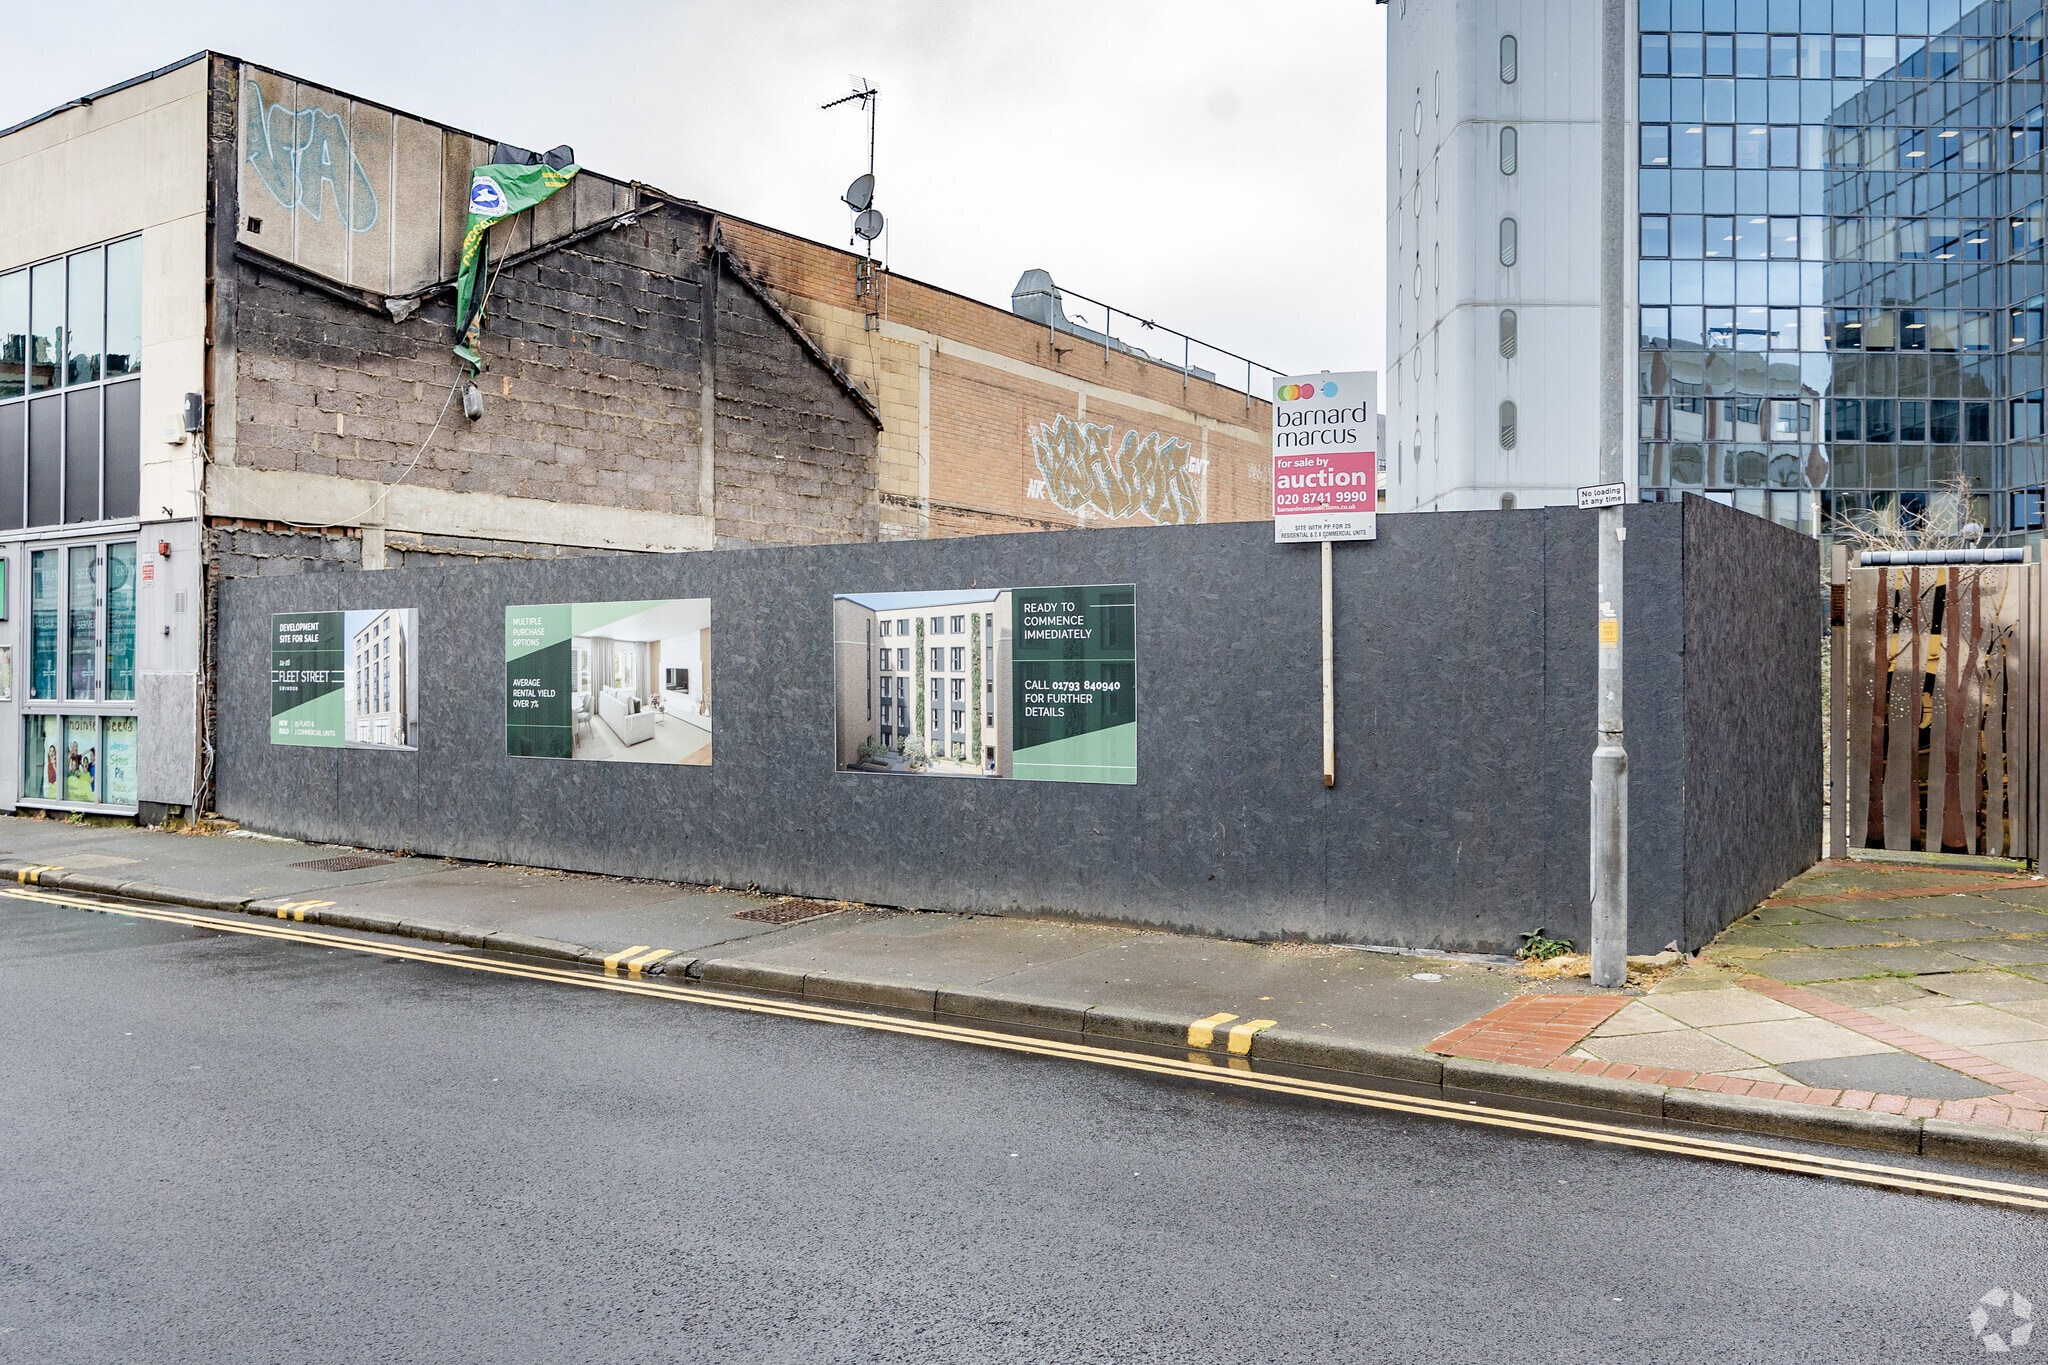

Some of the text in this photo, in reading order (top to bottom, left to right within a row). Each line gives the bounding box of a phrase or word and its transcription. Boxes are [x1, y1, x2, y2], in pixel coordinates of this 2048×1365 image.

[1277, 401, 1366, 428] barnard
[1277, 428, 1357, 448] marcus
[1277, 457, 1329, 468] for sale by
[1277, 468, 1366, 489] auction
[1594, 486, 1620, 496] loading
[1277, 490, 1367, 505] 020 8741 9990
[1024, 602, 1075, 613] READY TO
[512, 617, 542, 626] MULTIPLE
[1024, 615, 1084, 626] COMMENCE
[279, 622, 320, 632] DEVELOPMENT
[512, 628, 545, 636] PURCHASE
[279, 634, 319, 643] SITE FOR SALE
[1024, 628, 1092, 640] IMMEDIATELY
[512, 638, 540, 647] OPTIONS
[279, 670, 330, 682] FLEET STREET
[512, 678, 540, 687] AVERAGE
[1024, 680, 1121, 692] CALL 01793 840940
[513, 689, 556, 698] RENTAL YIELD
[1025, 694, 1093, 704] FOR FURTHER
[513, 700, 539, 709] OVER 7%
[1025, 706, 1065, 717] DETAILS
